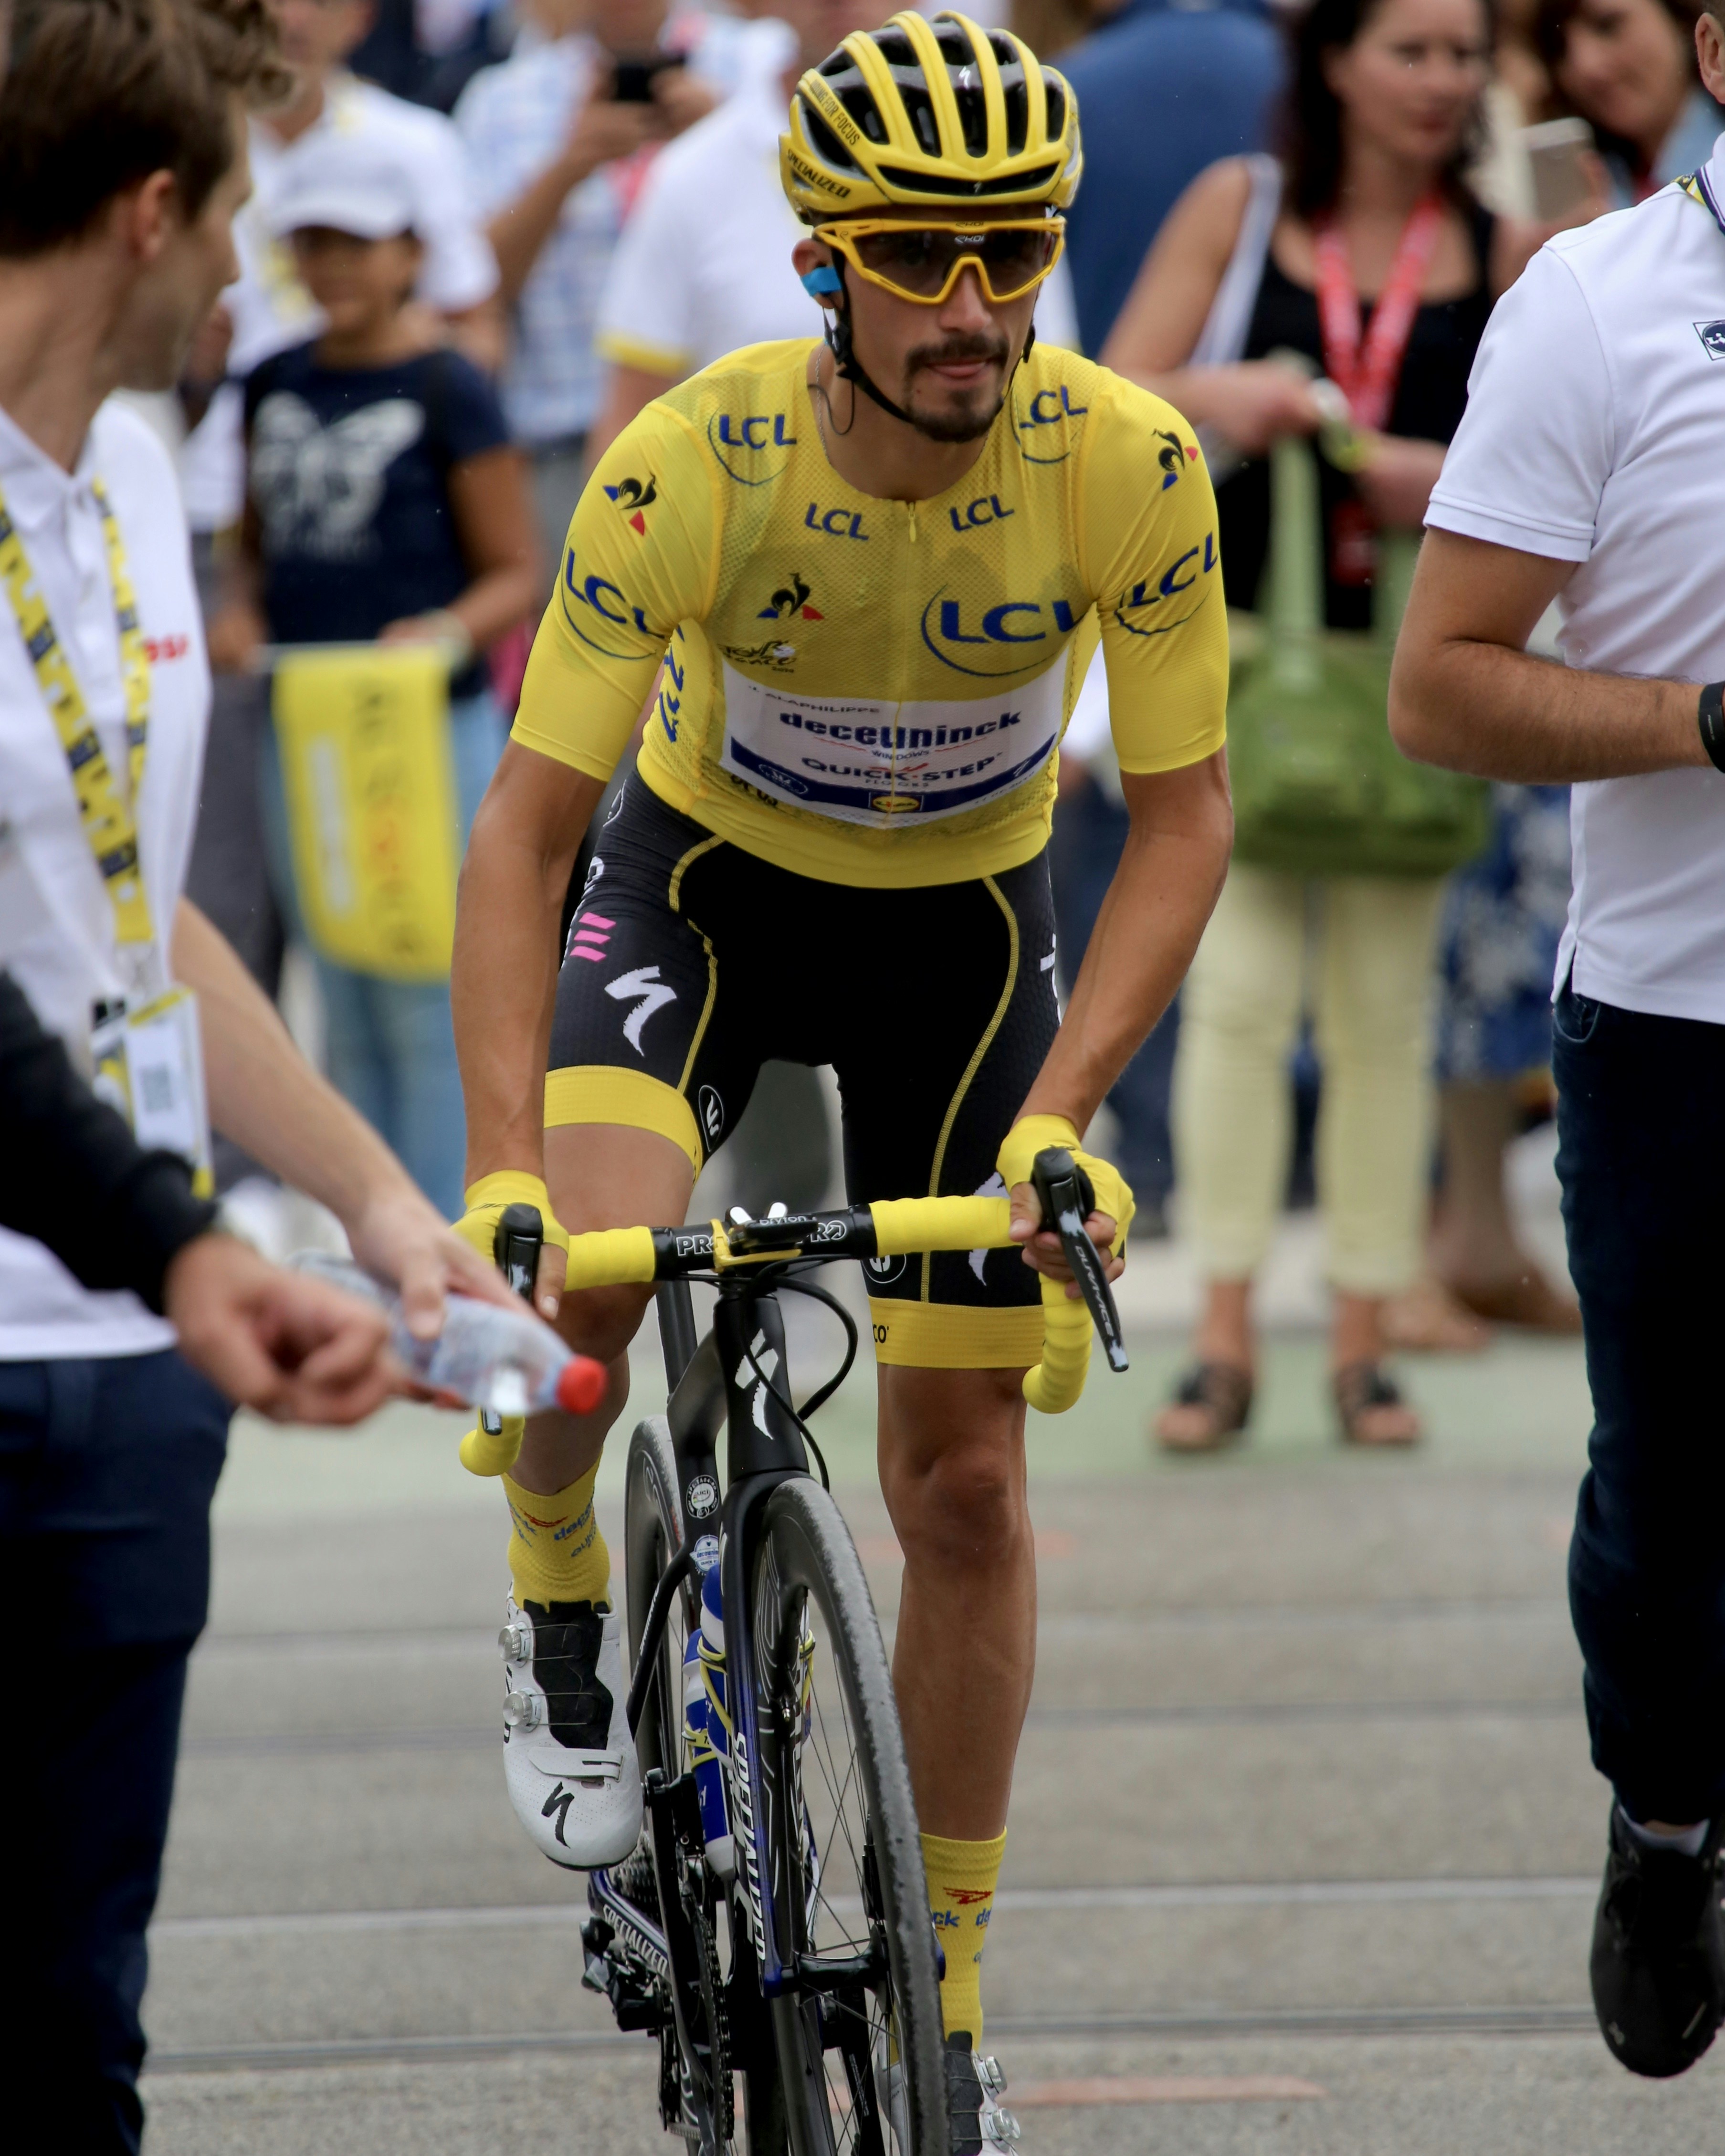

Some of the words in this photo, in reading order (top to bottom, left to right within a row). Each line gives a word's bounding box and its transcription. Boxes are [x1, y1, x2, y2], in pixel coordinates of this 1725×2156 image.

[822, 95, 839, 117] FOR
[834, 113, 860, 146] FOCUS
[788, 149, 851, 198] SPECIALIZED
[719, 414, 797, 450] LCL
[805, 503, 869, 541] LCL
[949, 494, 1014, 532] LCL
[1127, 531, 1218, 608] LCL
[940, 599, 1089, 644] LCL
[765, 693, 880, 713] ALAPHILIPPE
[779, 711, 1021, 749] deceuninck
[872, 749, 929, 760] WINDOWS
[735, 1732, 766, 1960] SPECIALIZED
[603, 1904, 668, 1976] SPECIALIZED
